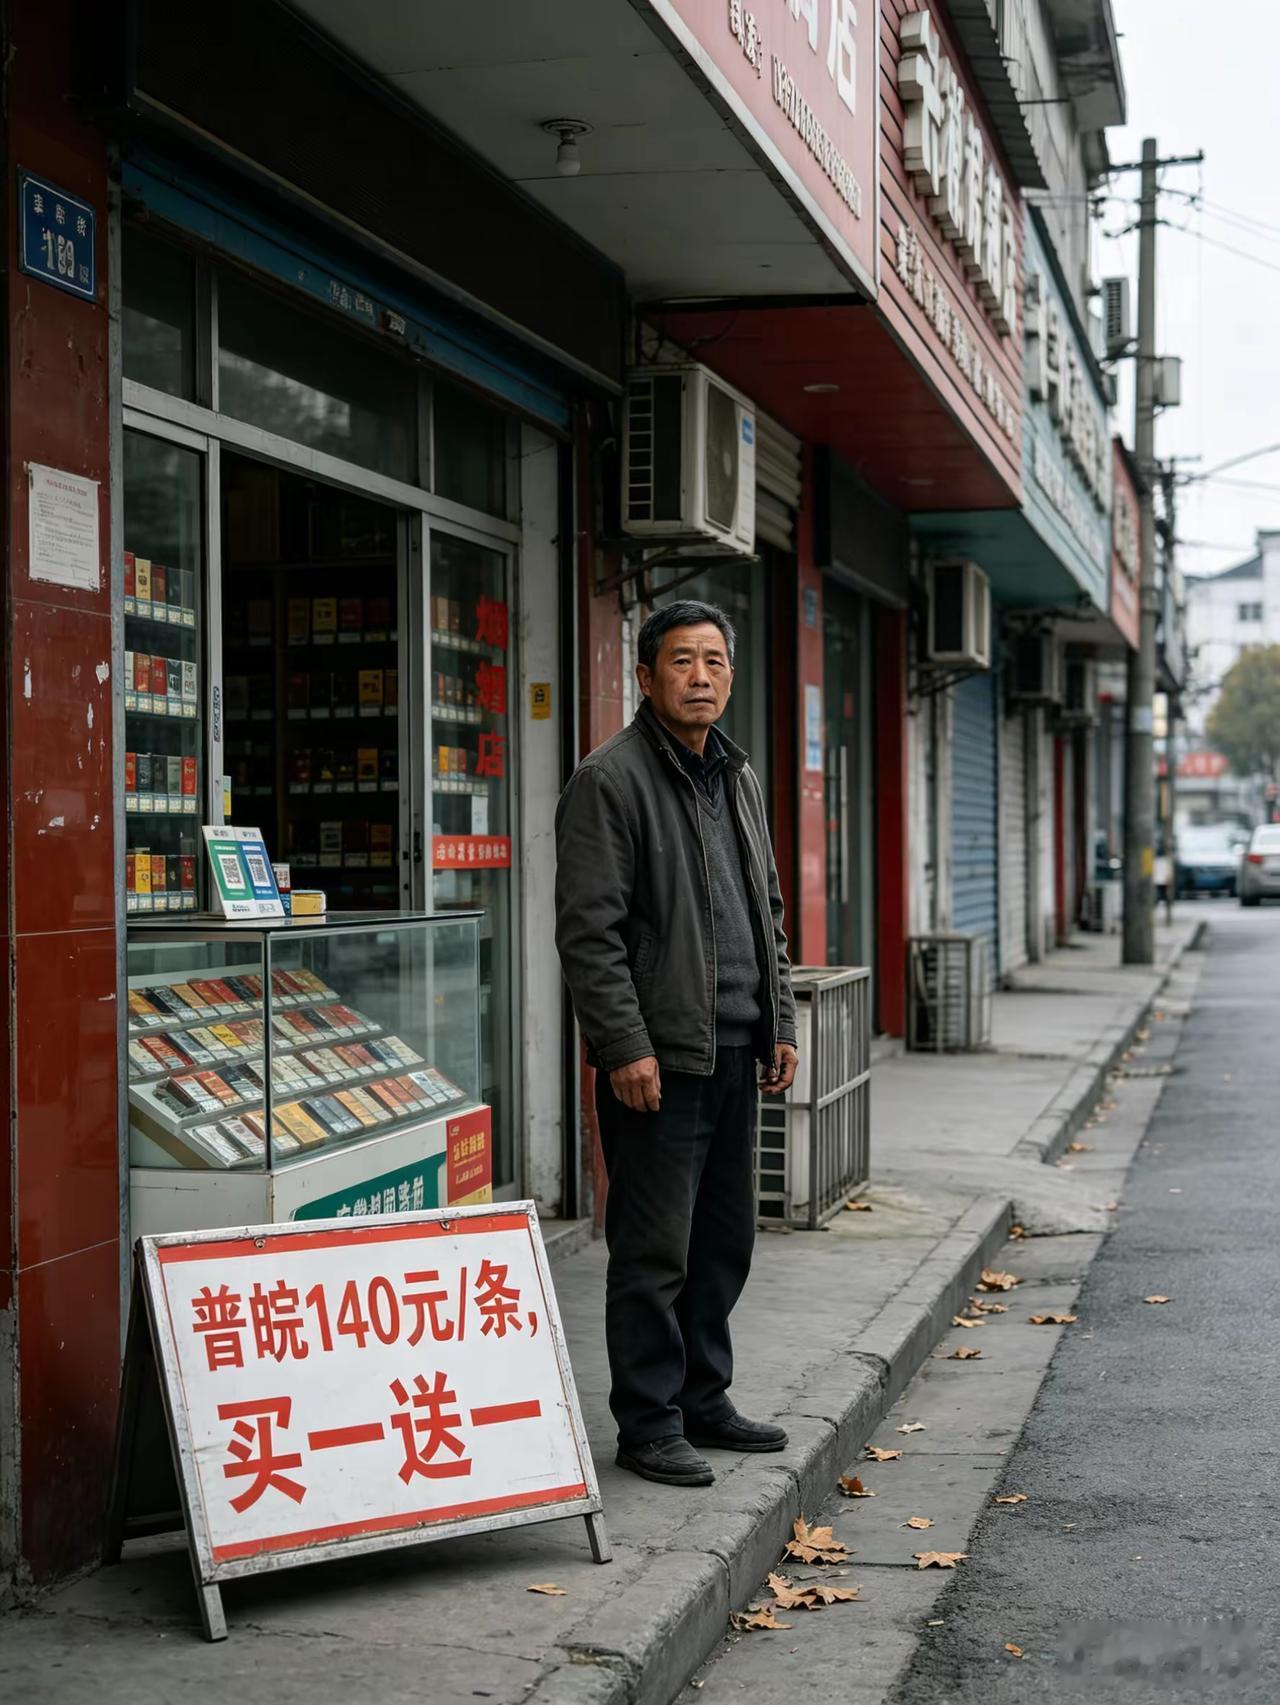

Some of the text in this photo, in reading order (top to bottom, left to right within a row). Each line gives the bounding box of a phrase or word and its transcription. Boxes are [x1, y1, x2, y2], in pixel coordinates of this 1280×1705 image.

[191, 1258, 538, 1372] 普皖140元/条,
[216, 1370, 542, 1514] 买一送一
